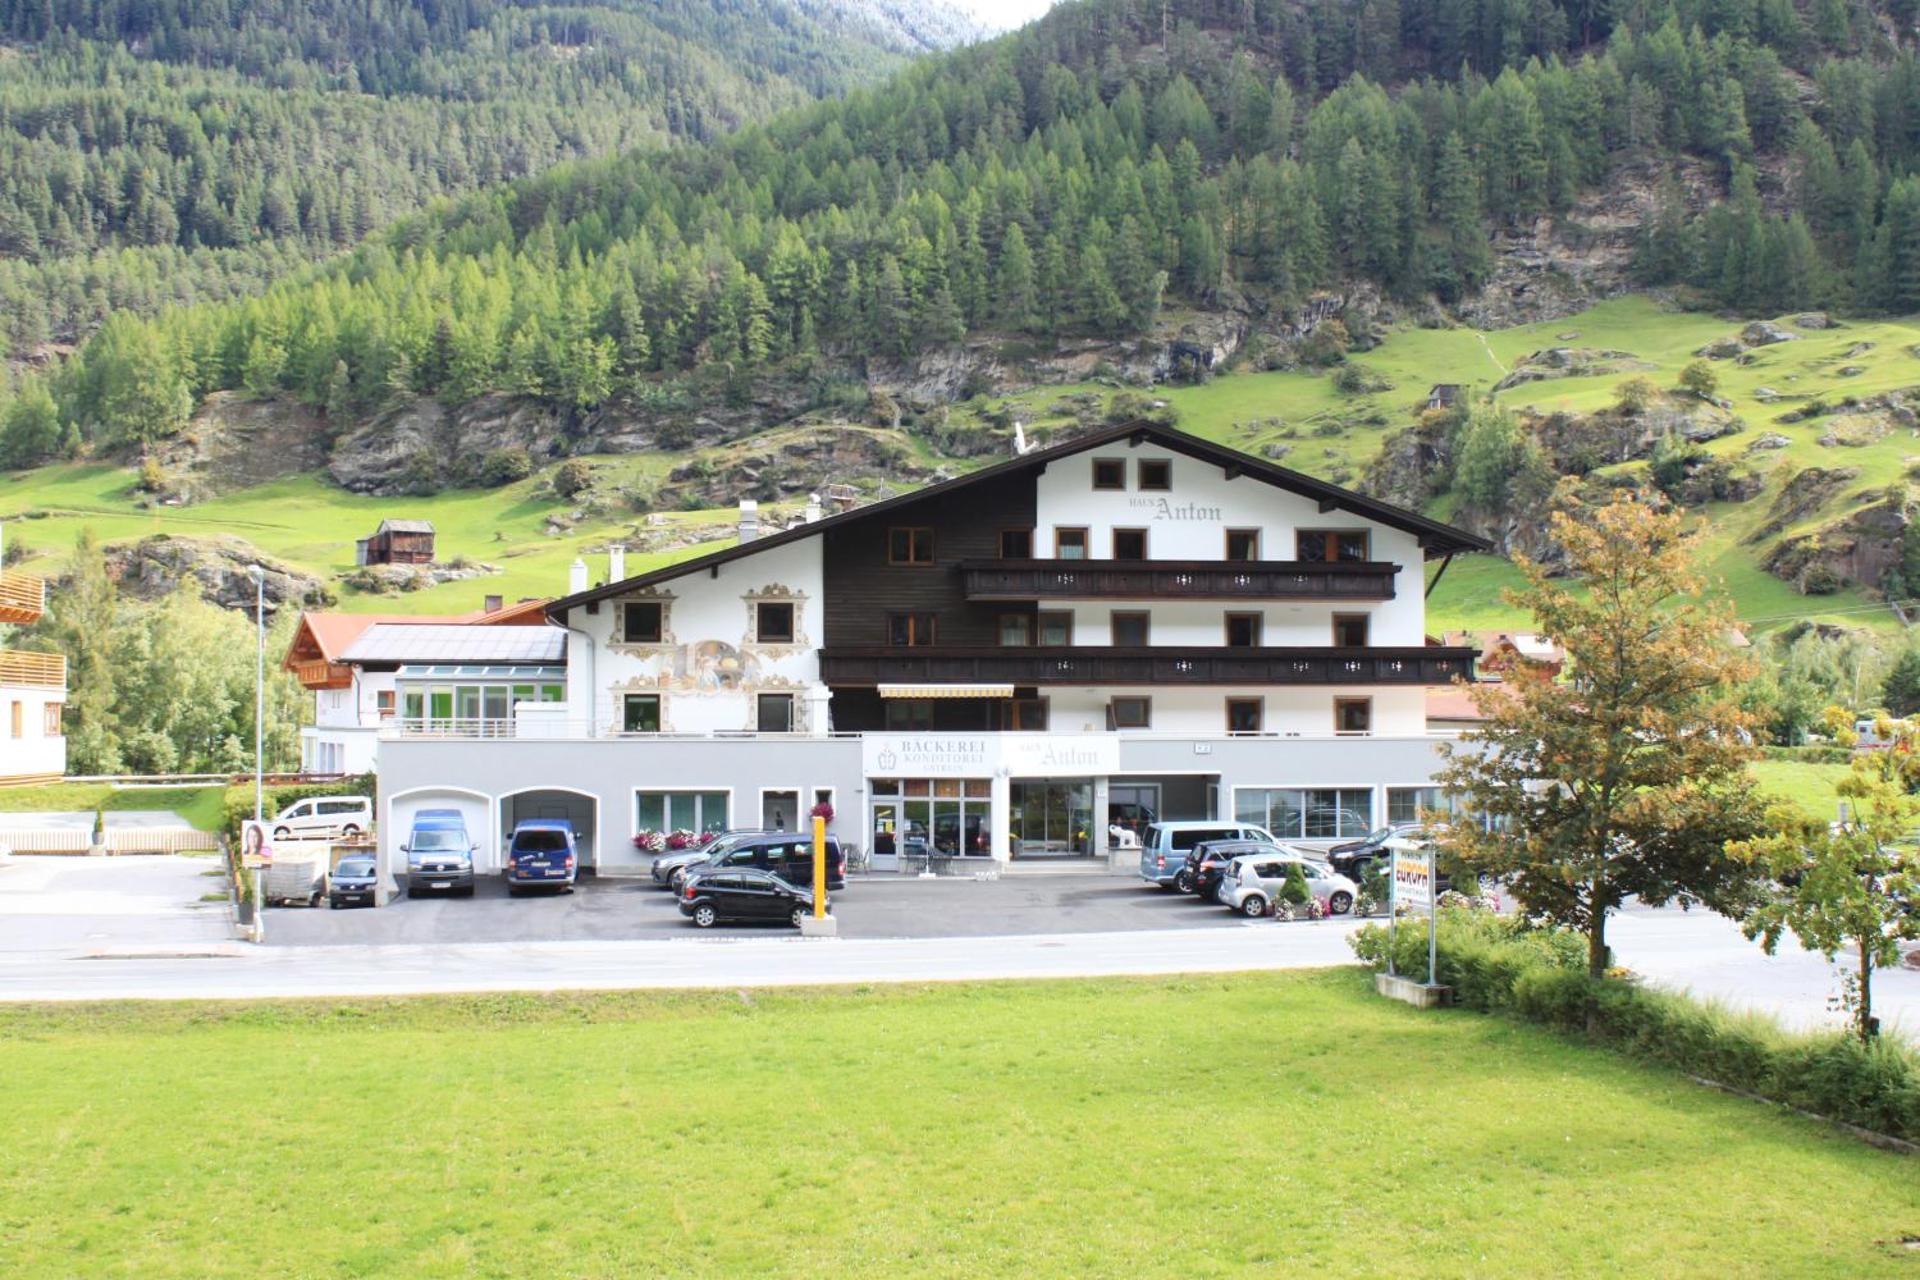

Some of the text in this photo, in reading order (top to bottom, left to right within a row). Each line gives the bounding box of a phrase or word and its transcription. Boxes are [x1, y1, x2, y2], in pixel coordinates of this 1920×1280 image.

[1129, 497, 1222, 521] HAUS Anton
[1041, 742, 1099, 766] Anton
